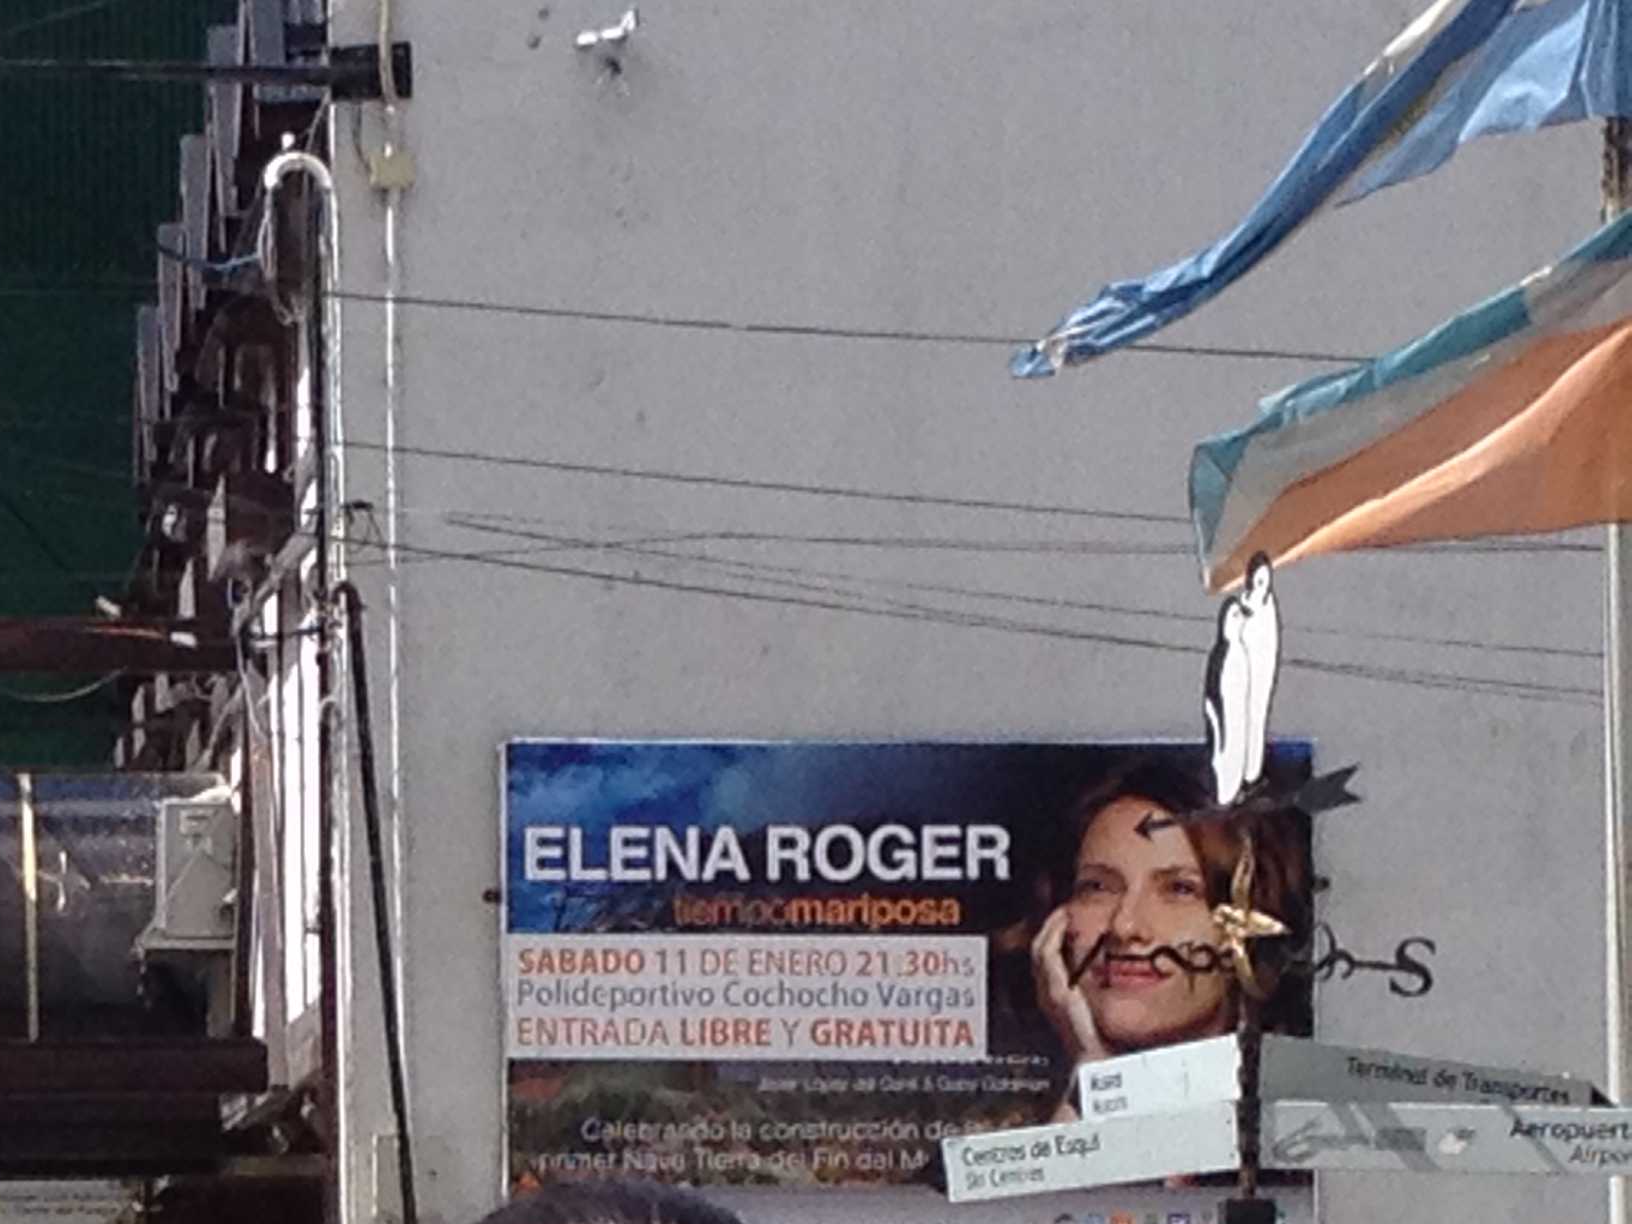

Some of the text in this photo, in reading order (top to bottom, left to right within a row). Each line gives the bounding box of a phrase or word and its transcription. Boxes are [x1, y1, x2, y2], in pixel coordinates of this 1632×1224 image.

[523, 824, 1011, 881] ELENA ROGER
[518, 949, 645, 974] SABADO
[656, 950, 689, 974] 11
[699, 951, 738, 975] DE
[747, 951, 848, 976] ENERO
[517, 978, 976, 1014] Polideportivo Cochocho Vargas
[517, 1018, 976, 1048] ENTRADA LIBRE Y GRATUITA
[1509, 1116, 1632, 1144] Aeropuert
[1569, 1144, 1632, 1168] Airpor
